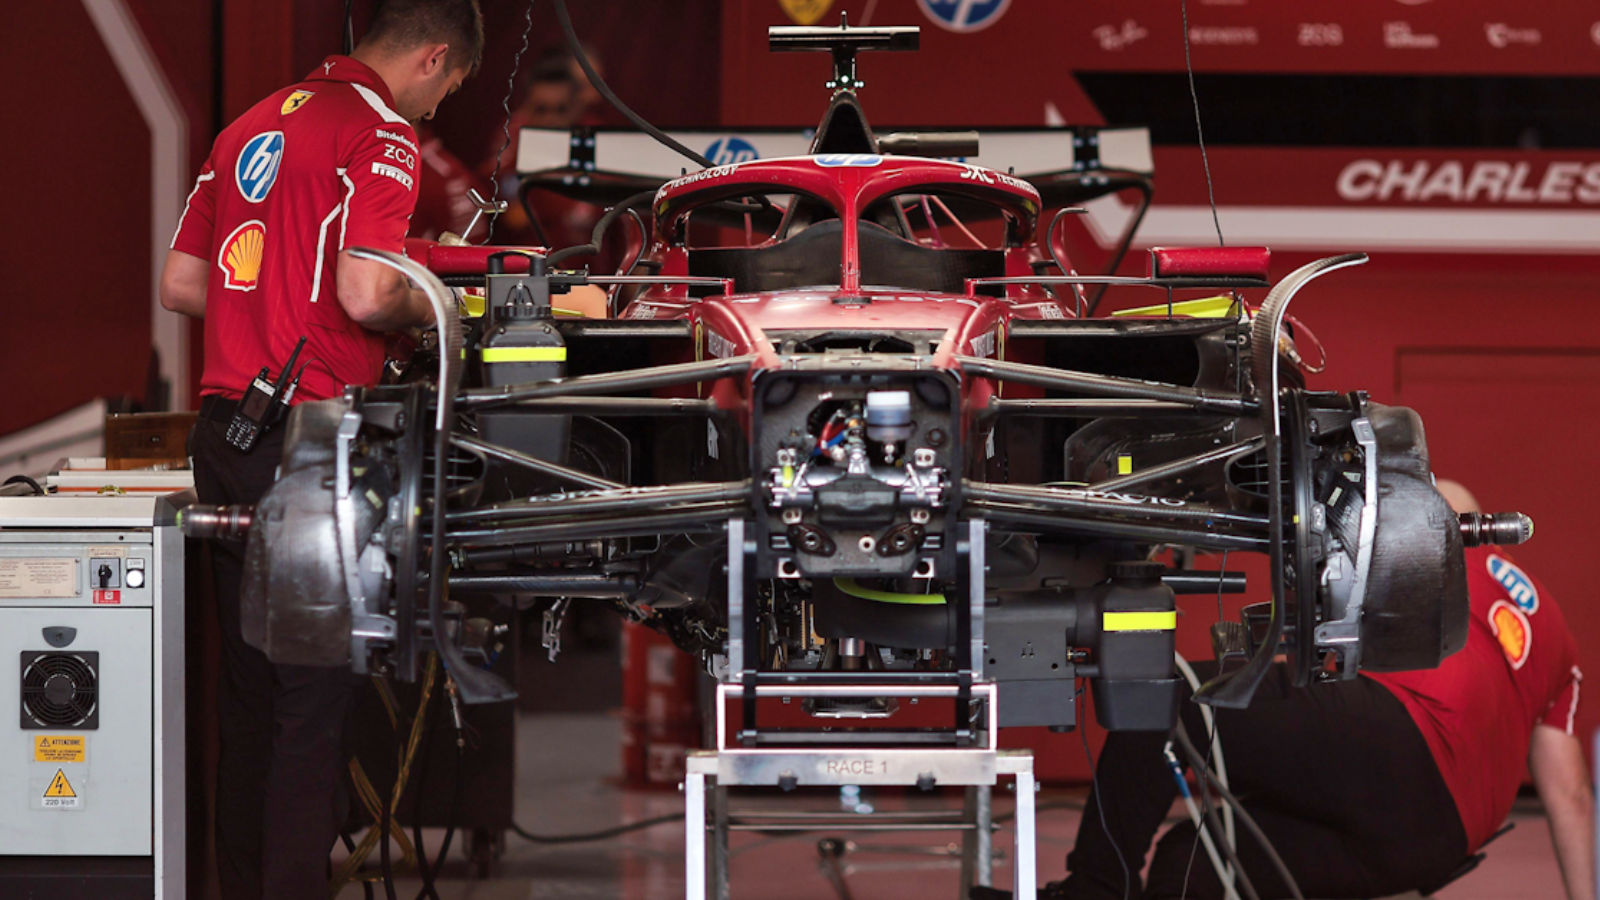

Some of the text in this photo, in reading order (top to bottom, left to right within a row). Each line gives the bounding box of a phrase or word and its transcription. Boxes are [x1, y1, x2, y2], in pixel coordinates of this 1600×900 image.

[239, 131, 282, 201] hp
[384, 143, 415, 170] ZCG
[1336, 159, 1600, 202] CHARLES
[827, 759, 888, 775] RACE 1
